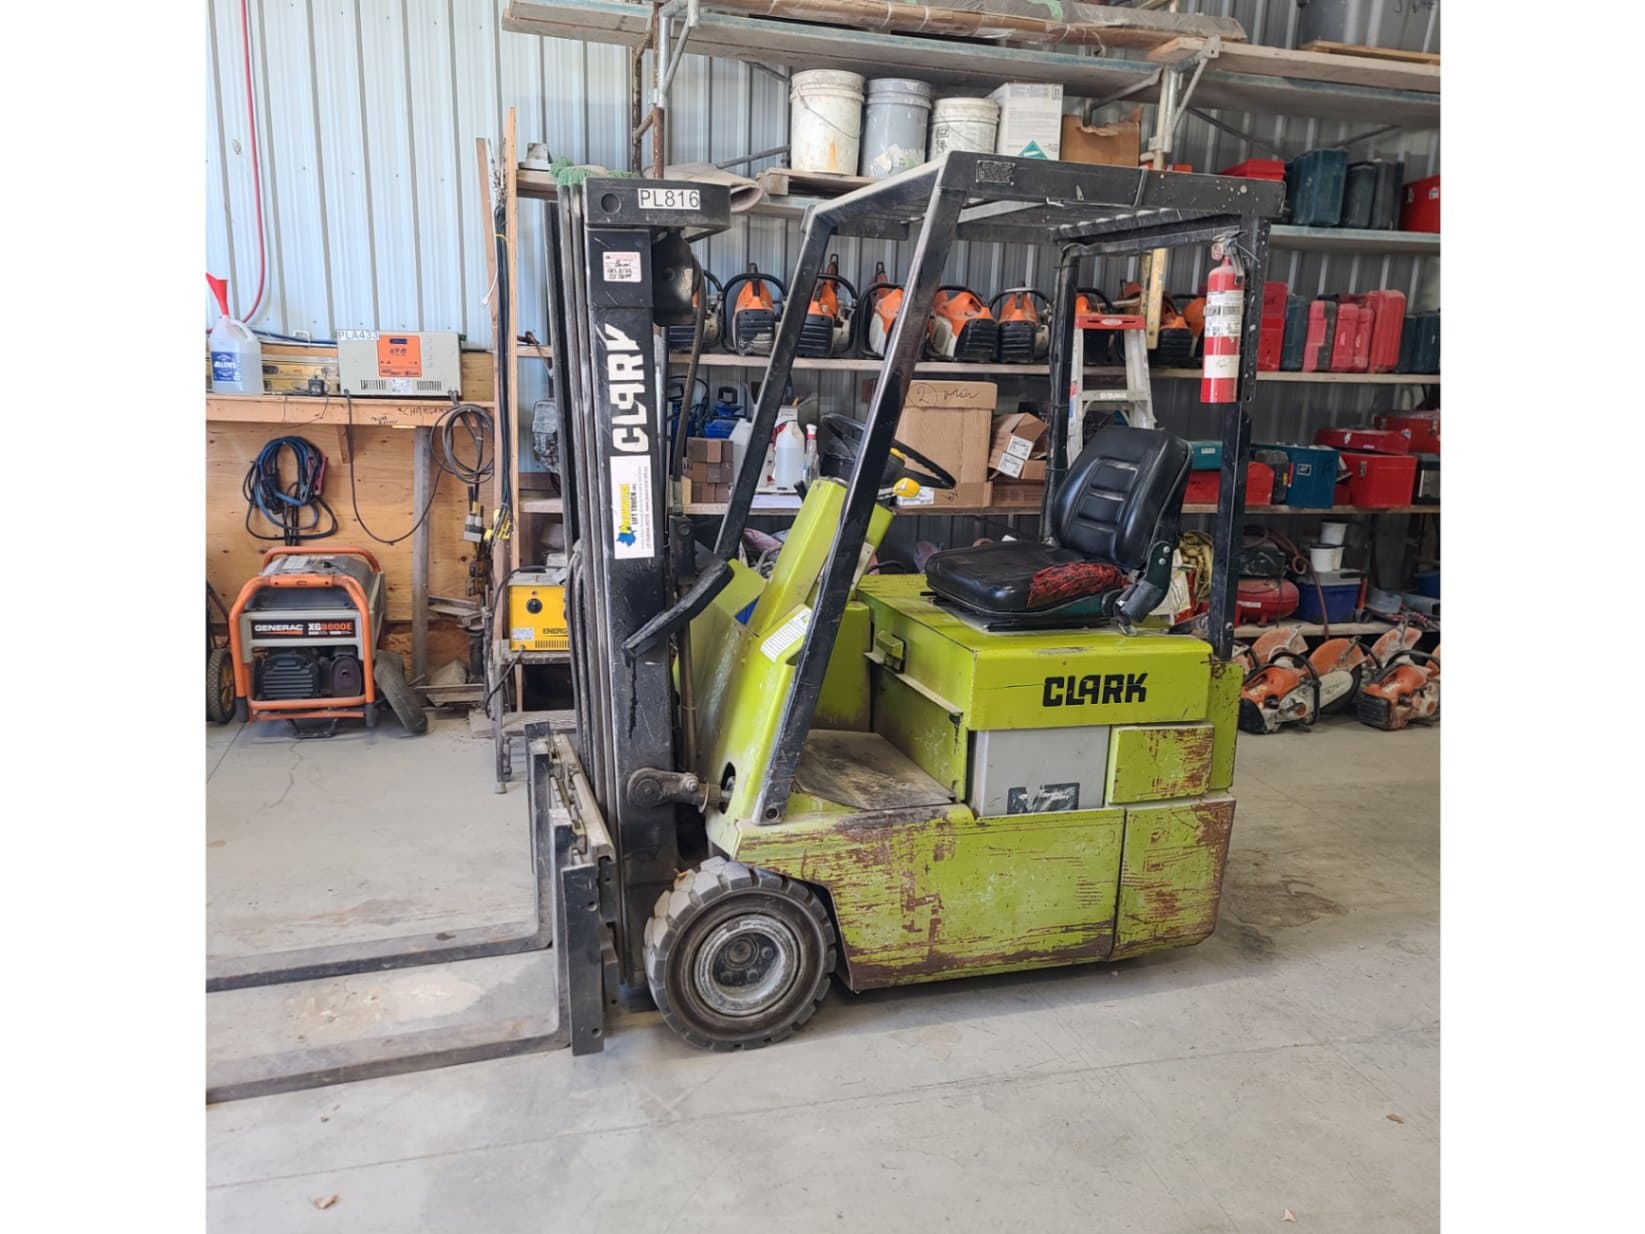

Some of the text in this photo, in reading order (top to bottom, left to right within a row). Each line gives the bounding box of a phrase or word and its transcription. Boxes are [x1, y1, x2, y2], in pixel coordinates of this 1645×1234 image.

[639, 189, 699, 208] PL816
[605, 323, 648, 453] CLARK
[254, 624, 304, 632] GENERAC
[1042, 672, 1149, 707] CLARK
